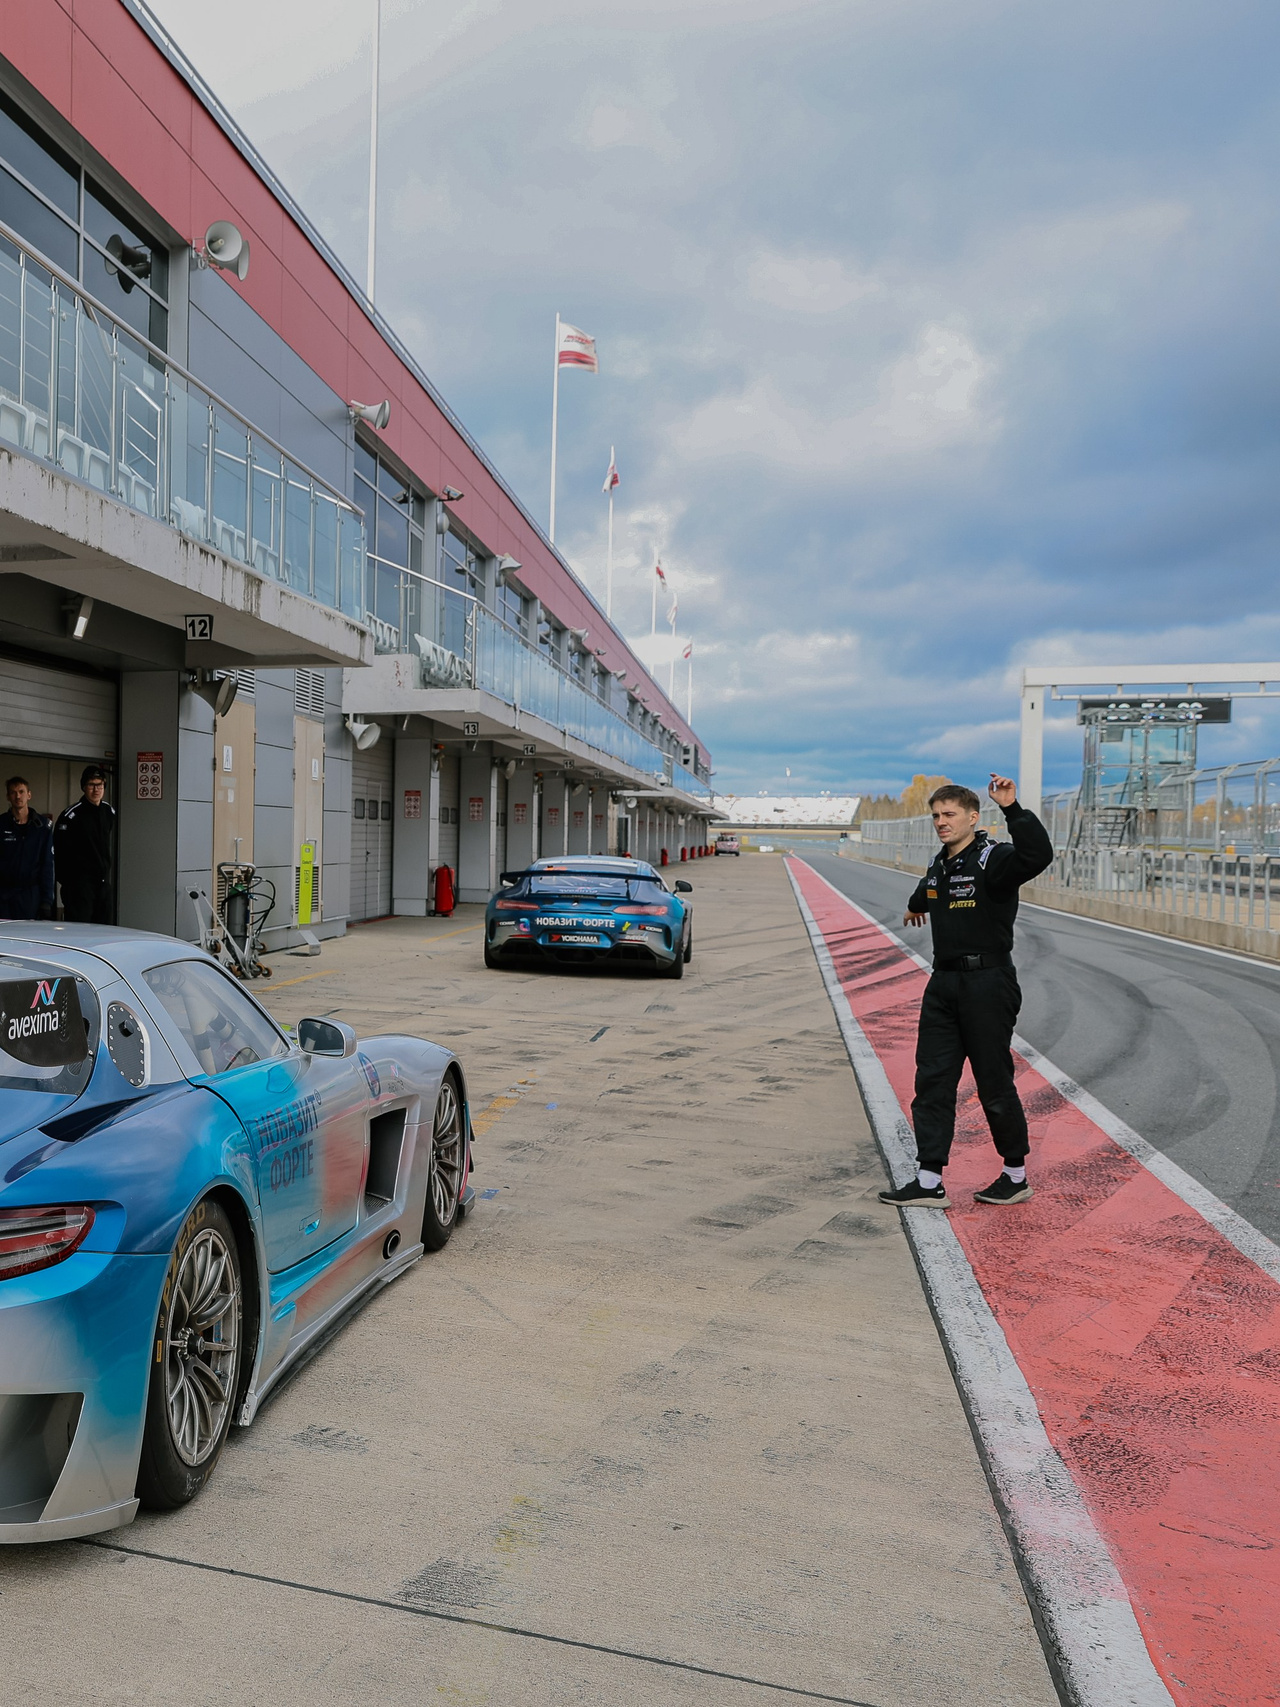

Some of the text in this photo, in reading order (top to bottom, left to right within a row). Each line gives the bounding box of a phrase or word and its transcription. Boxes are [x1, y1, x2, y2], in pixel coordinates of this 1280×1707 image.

[188, 619, 209, 638] 12
[465, 724, 477, 735] 13
[525, 746, 534, 755] 14
[583, 918, 616, 928] ФОРТЕ
[561, 935, 598, 943] YOKOHAMA
[8, 1007, 59, 1040] avexima
[270, 1139, 315, 1195] ФОРТЕ
